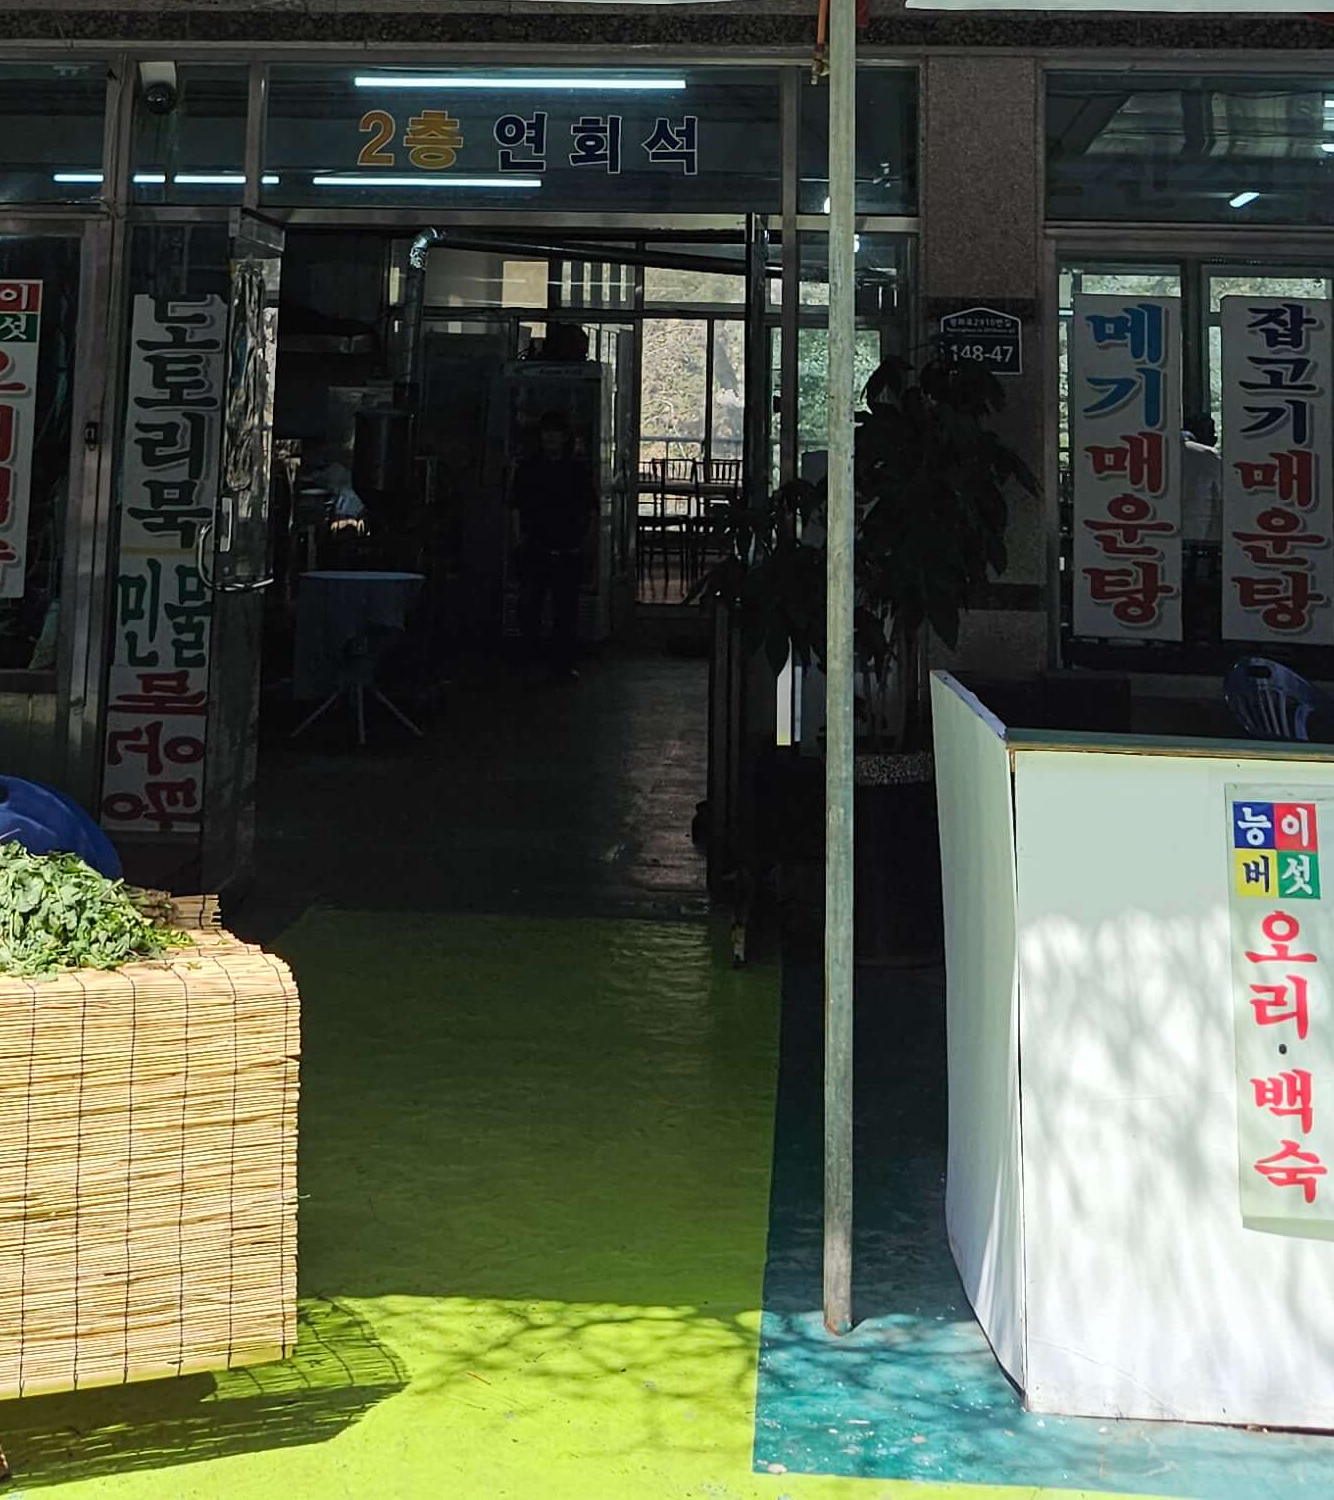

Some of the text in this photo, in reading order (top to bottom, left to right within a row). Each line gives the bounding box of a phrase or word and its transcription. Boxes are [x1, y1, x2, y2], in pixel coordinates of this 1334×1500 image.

[357, 109, 698, 174] 2층 연회석
[127, 296, 221, 548] 도토리묵
[1083, 303, 1173, 625] 메기매운탕
[1232, 304, 1324, 629] 잡고기매운탕
[1237, 806, 1309, 847] 능이
[1243, 854, 1314, 896] 버섯
